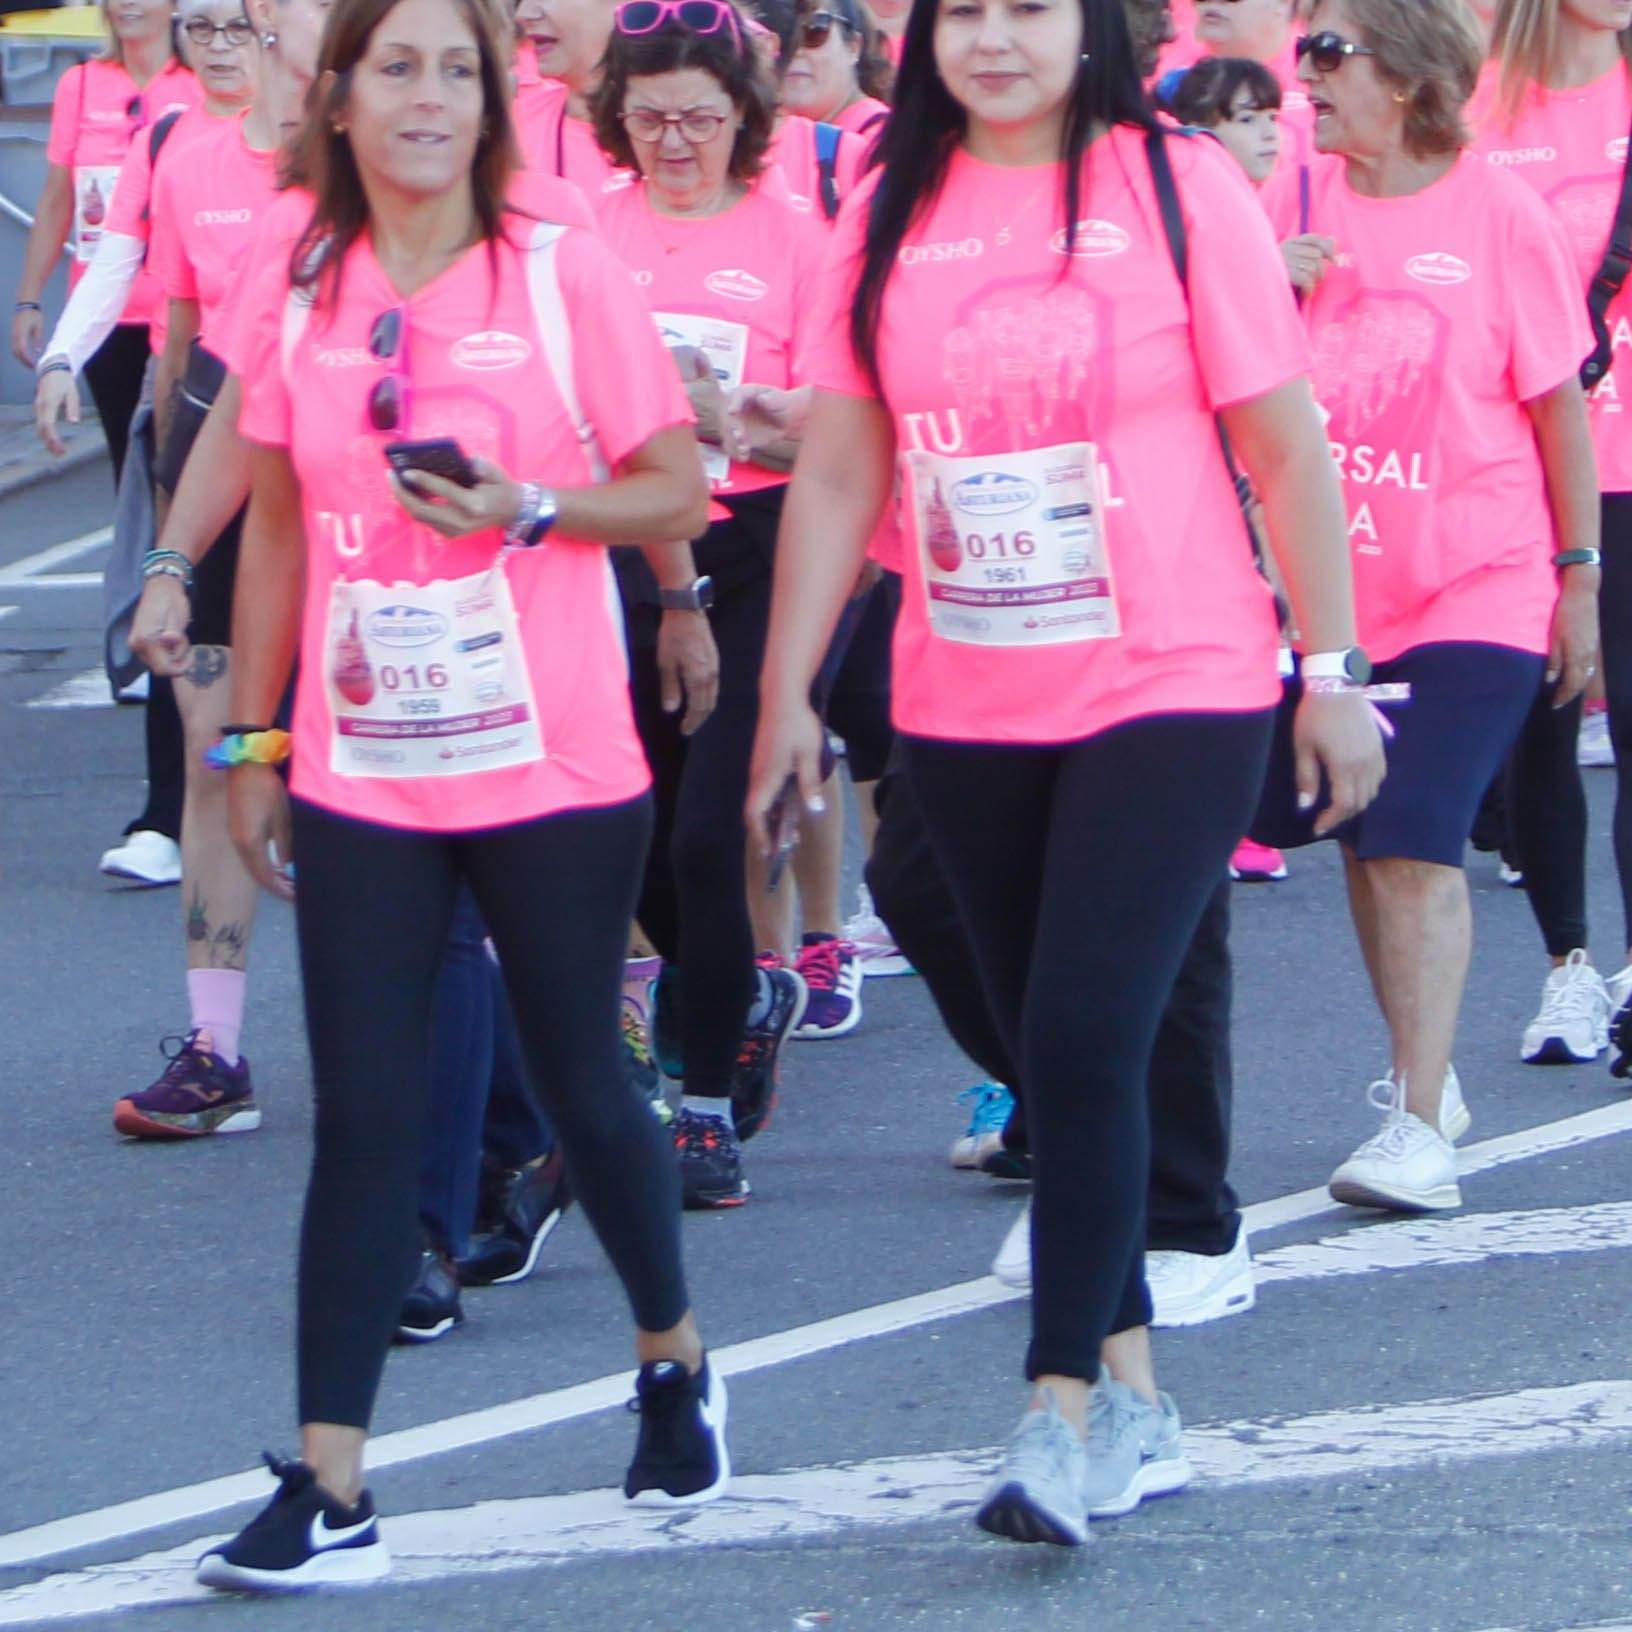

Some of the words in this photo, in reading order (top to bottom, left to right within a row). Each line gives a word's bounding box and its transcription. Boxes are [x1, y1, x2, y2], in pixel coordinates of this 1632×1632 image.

[1488, 146, 1556, 165] OYSHO
[899, 238, 984, 265] OYSHO
[904, 409, 963, 452] TU
[1328, 441, 1429, 490] RSAL
[966, 530, 1036, 559] 016
[380, 663, 448, 690] 016
